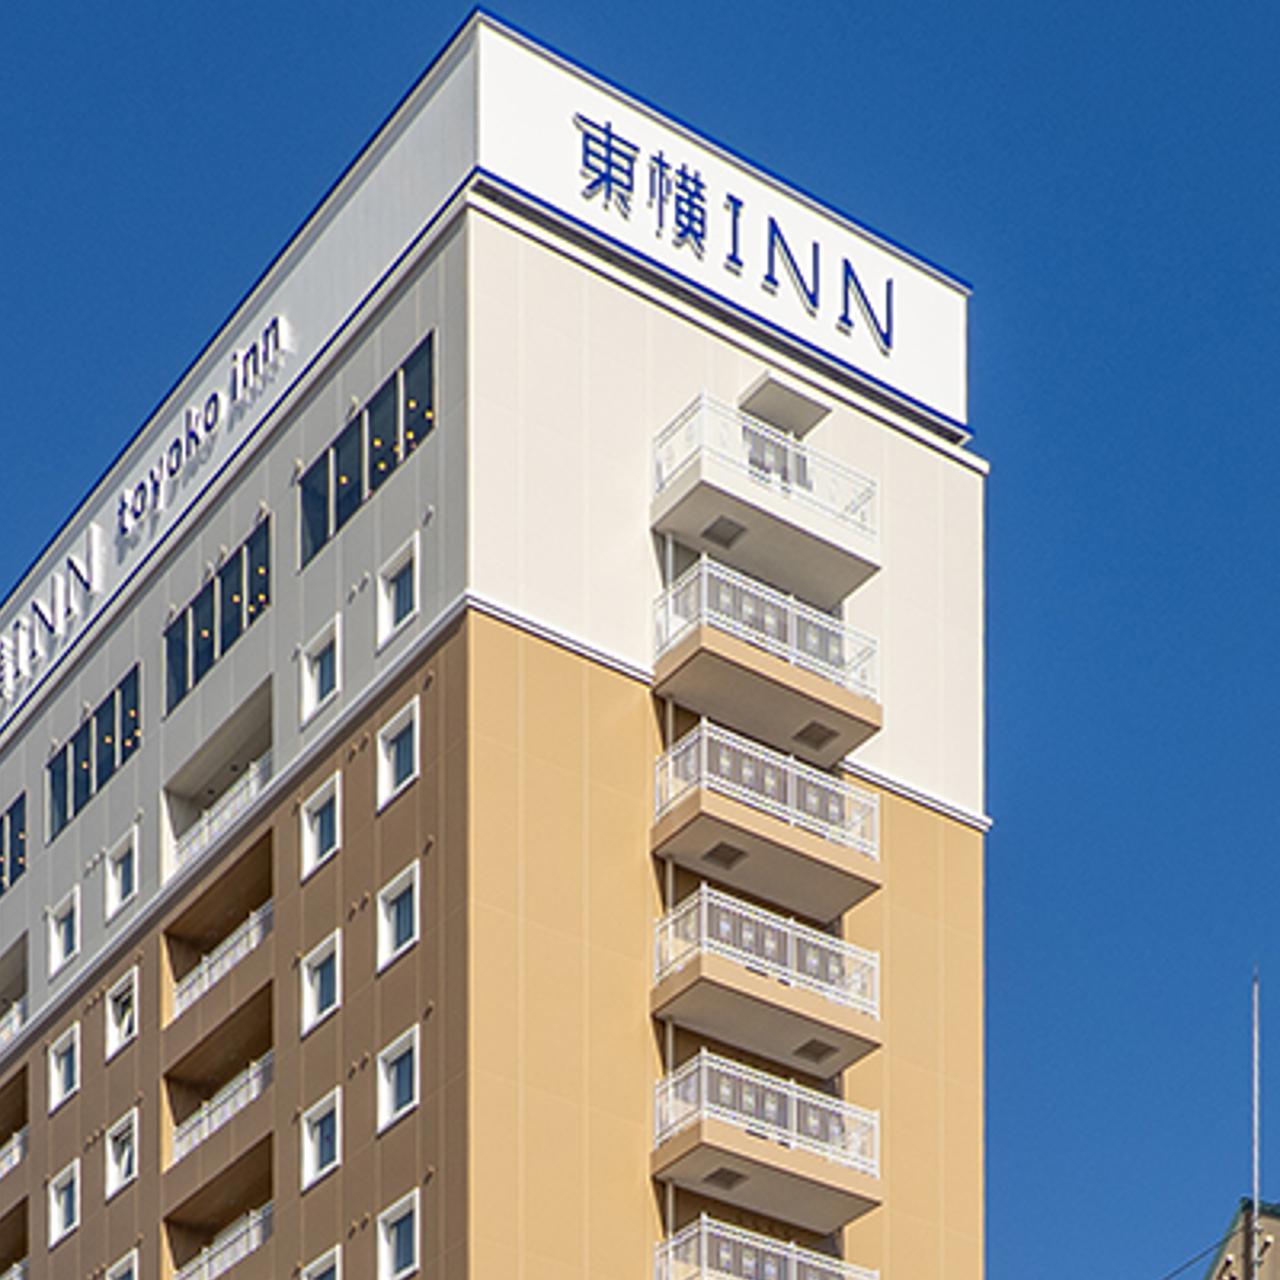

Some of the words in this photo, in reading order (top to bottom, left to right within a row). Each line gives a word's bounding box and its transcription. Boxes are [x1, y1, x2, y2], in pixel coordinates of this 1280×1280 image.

[572, 111, 894, 354] 東横INN
[114, 388, 220, 536] toyoko
[229, 316, 282, 402] inn
